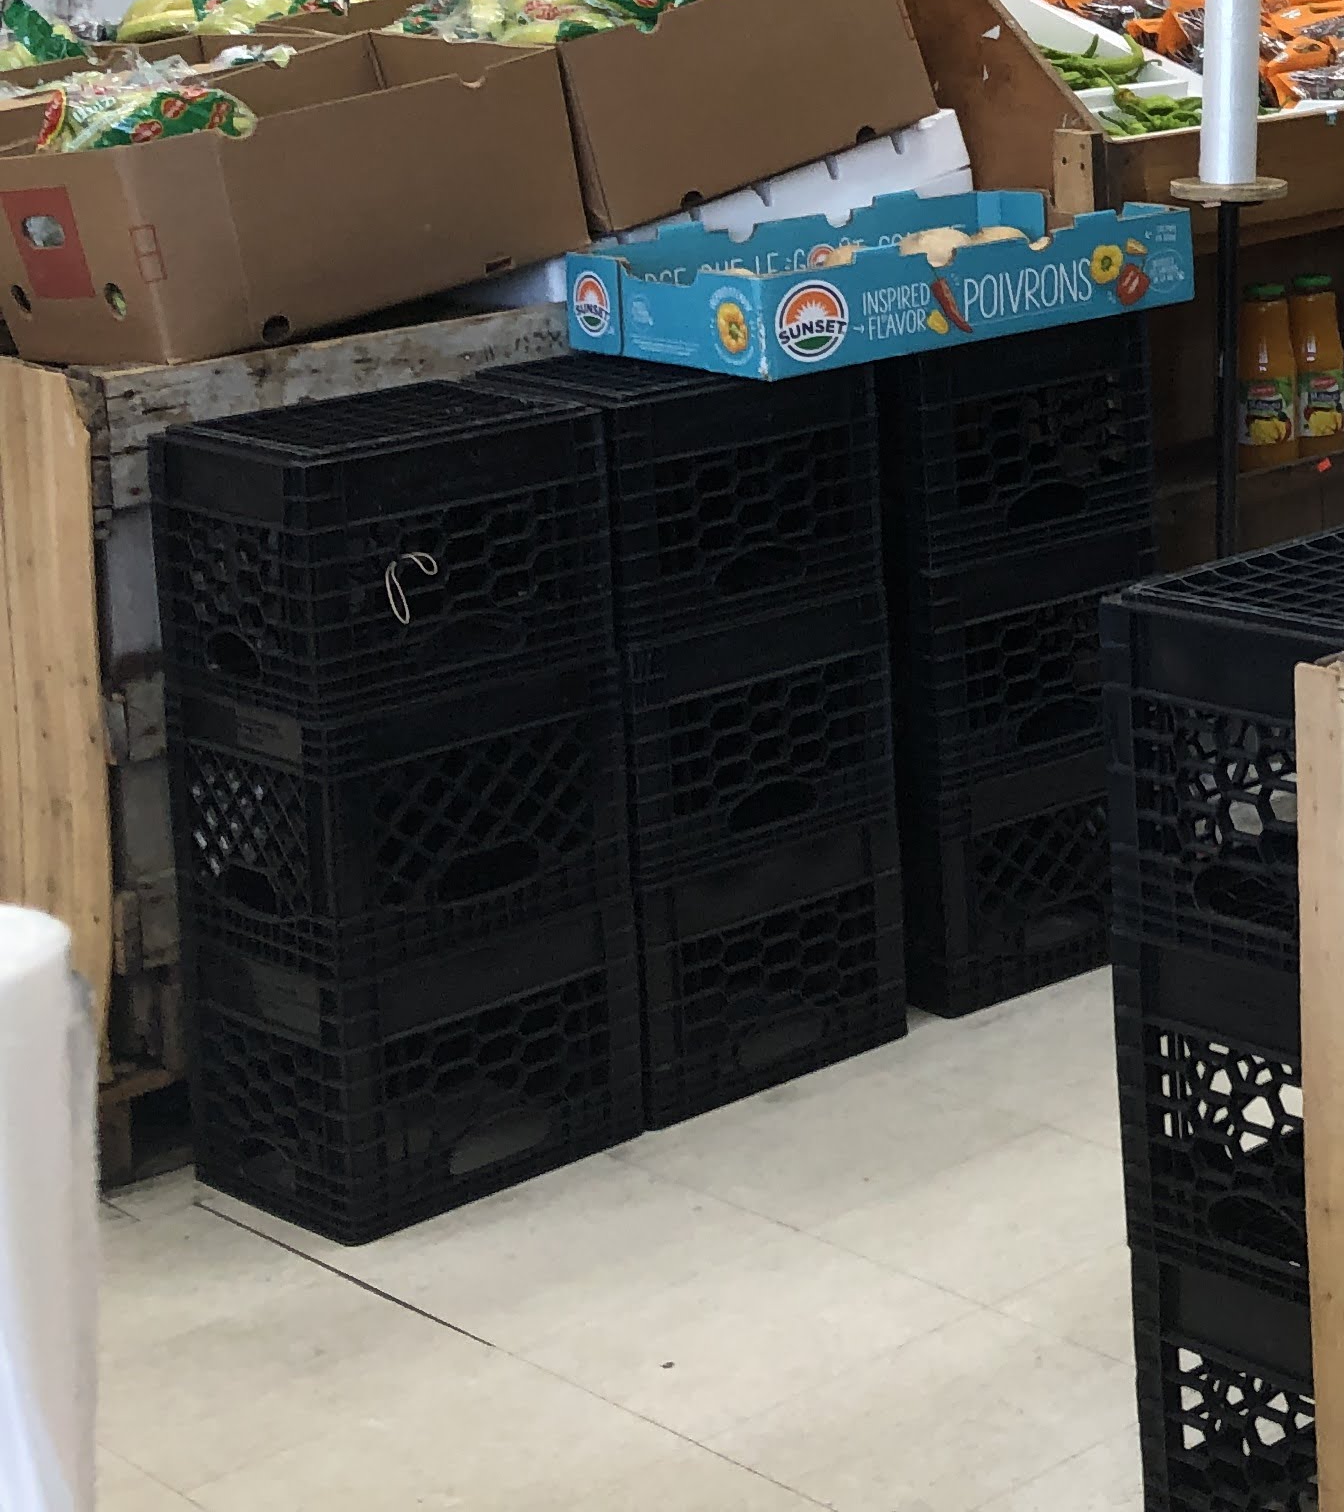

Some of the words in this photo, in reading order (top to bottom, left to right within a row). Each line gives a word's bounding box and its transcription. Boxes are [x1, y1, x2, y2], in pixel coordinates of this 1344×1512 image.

[862, 281, 931, 316] INSPIRED
[963, 258, 1093, 322] POIVRONS
[575, 304, 611, 319] SUNSET
[868, 309, 928, 341] FLAVOR
[778, 319, 848, 346] SUNSET
